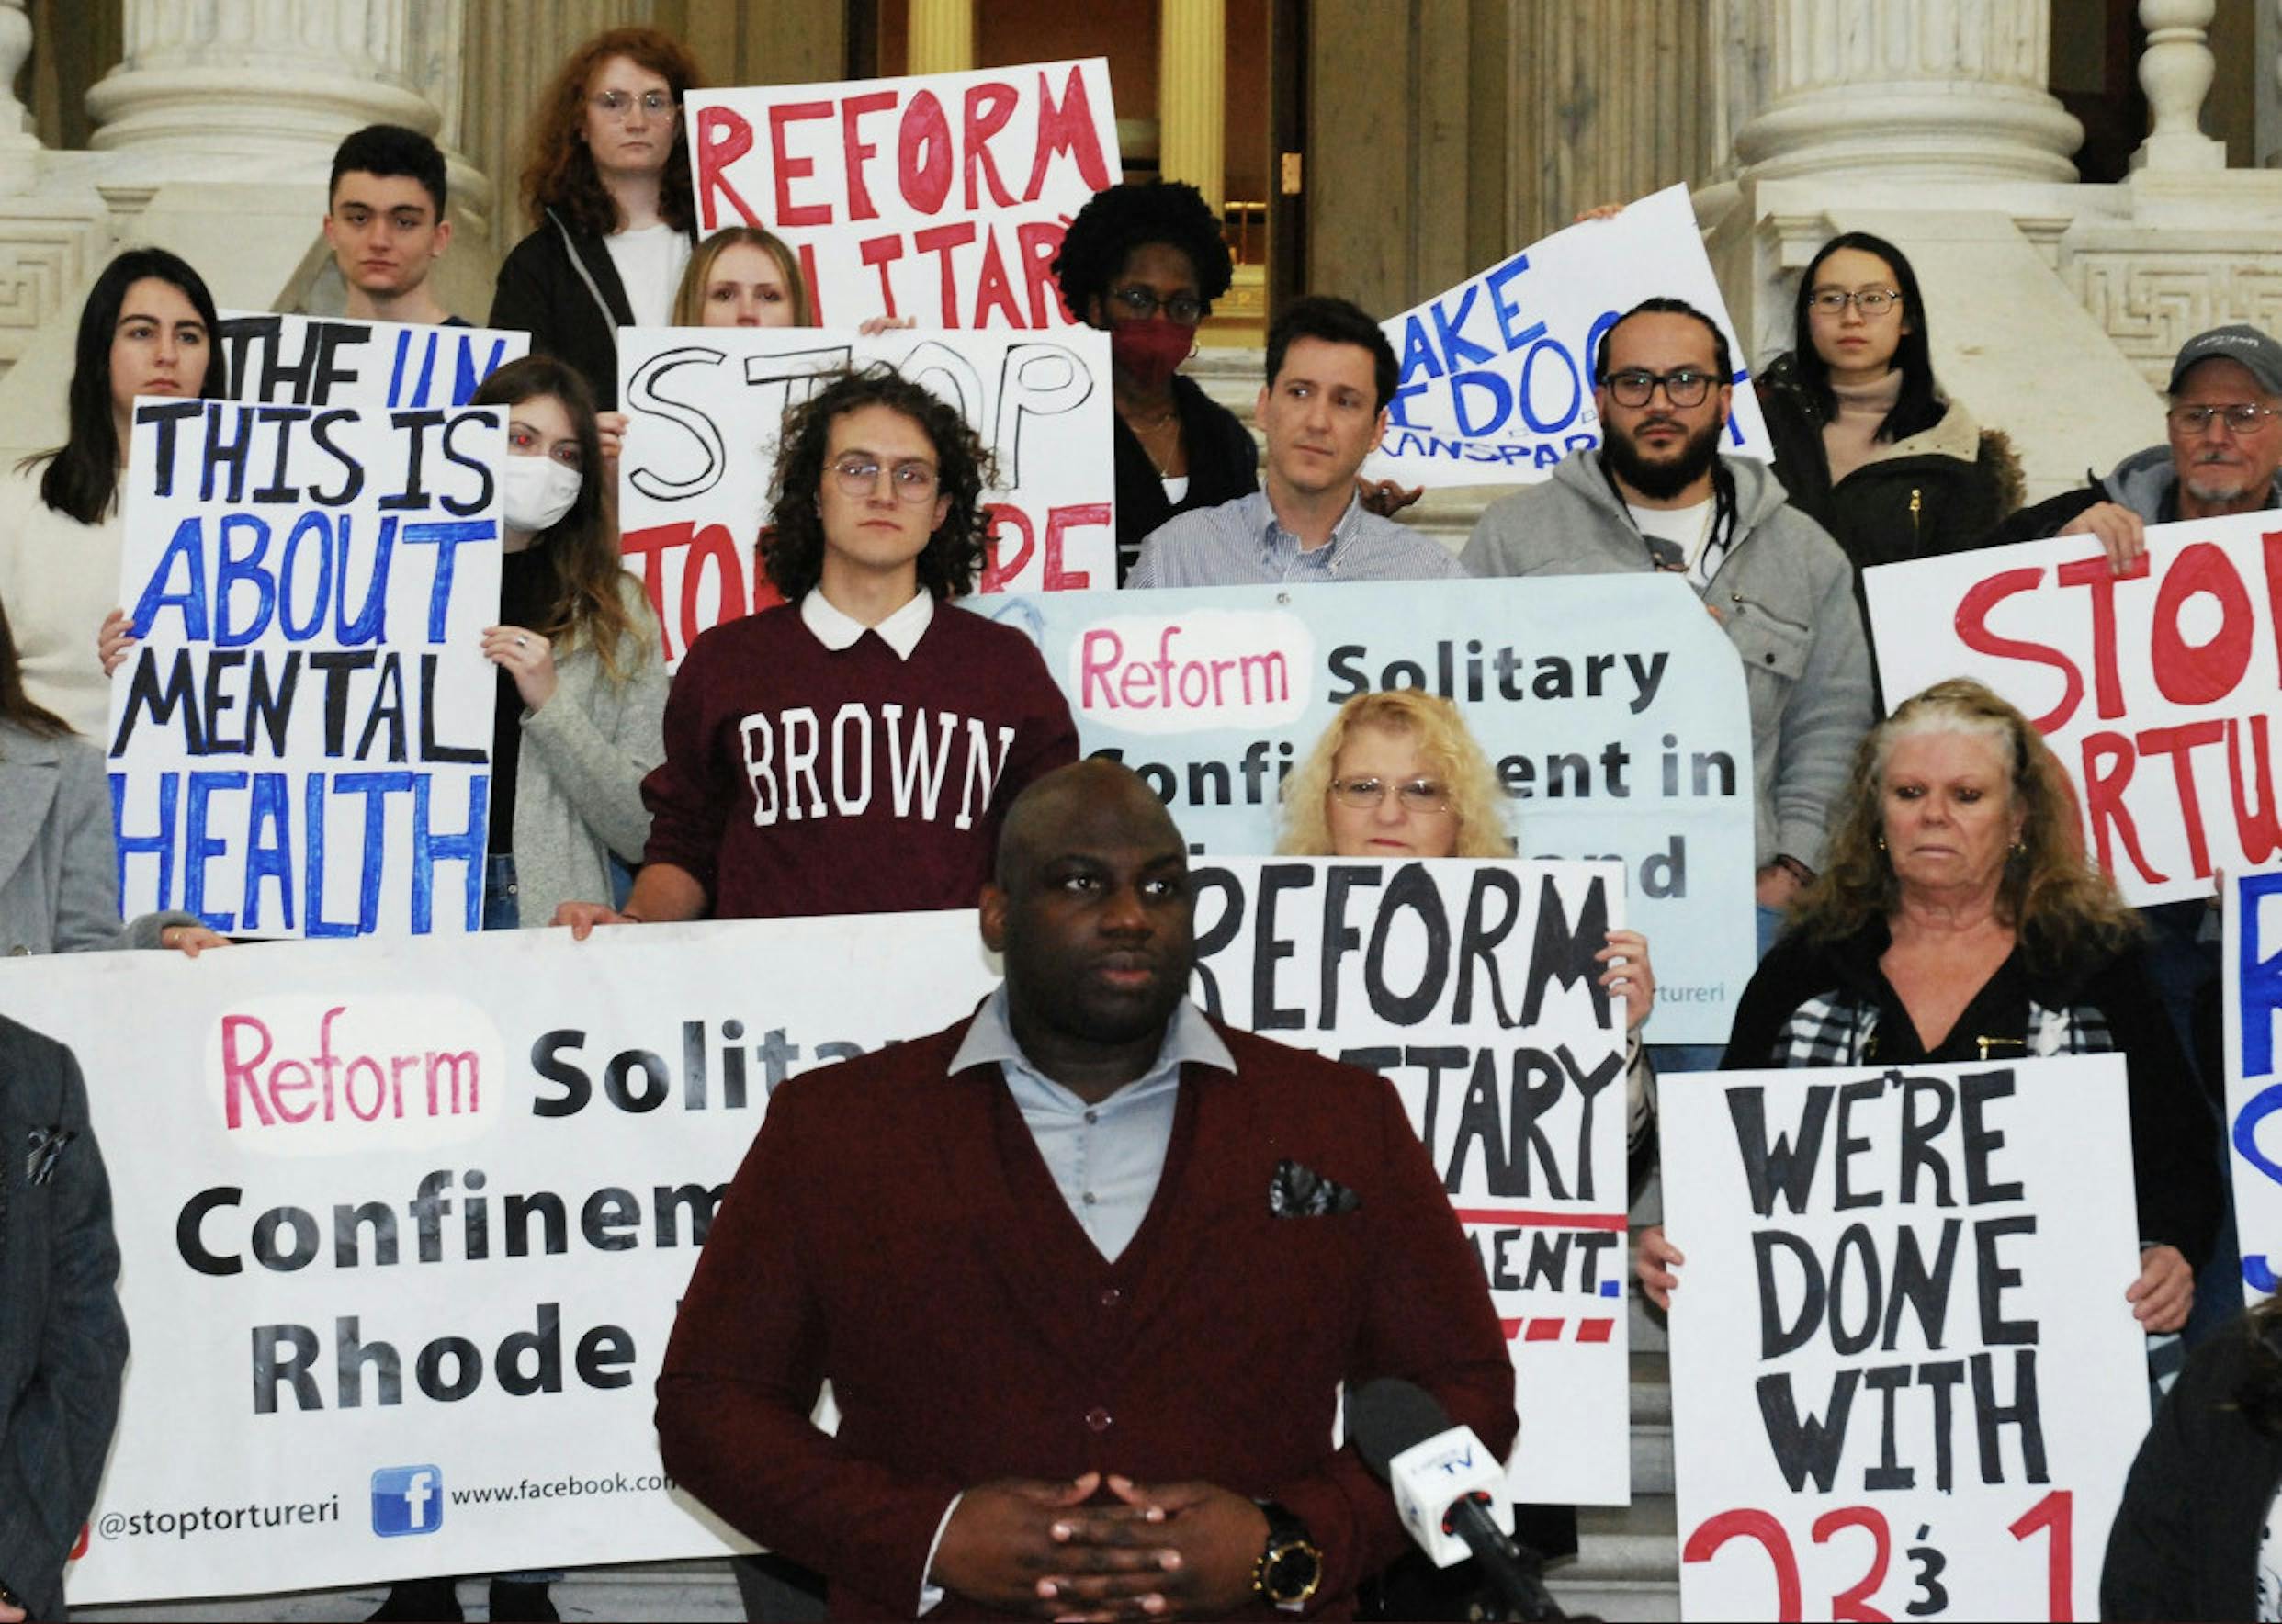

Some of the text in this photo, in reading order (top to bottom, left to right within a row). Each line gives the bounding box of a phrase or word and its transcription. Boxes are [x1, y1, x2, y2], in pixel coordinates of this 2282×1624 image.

[696, 64, 1111, 231] REFORM
[218, 316, 371, 406] THE
[1399, 254, 1548, 385] AKE
[135, 400, 500, 515] THIS IS
[130, 510, 497, 647] ABOUT
[621, 502, 1113, 663] TORE
[108, 646, 489, 764] MENTAL
[1081, 626, 1670, 716] Reform Solitary
[739, 702, 1015, 830] BROWN
[1661, 733, 1736, 797] in
[108, 772, 489, 938] HEALTH
[1192, 861, 1613, 1031] REFORM
[221, 1008, 904, 1131] Reform Solit
[1725, 1069, 2024, 1218] WE'RE
[175, 1169, 735, 1278] Confinem
[1752, 1215, 2039, 1359] DONE
[252, 1303, 637, 1415] Rhode
[1755, 1349, 2050, 1494] WITH
[98, 1496, 340, 1541] @stoptortureri
[2008, 1490, 2073, 1622] 1
